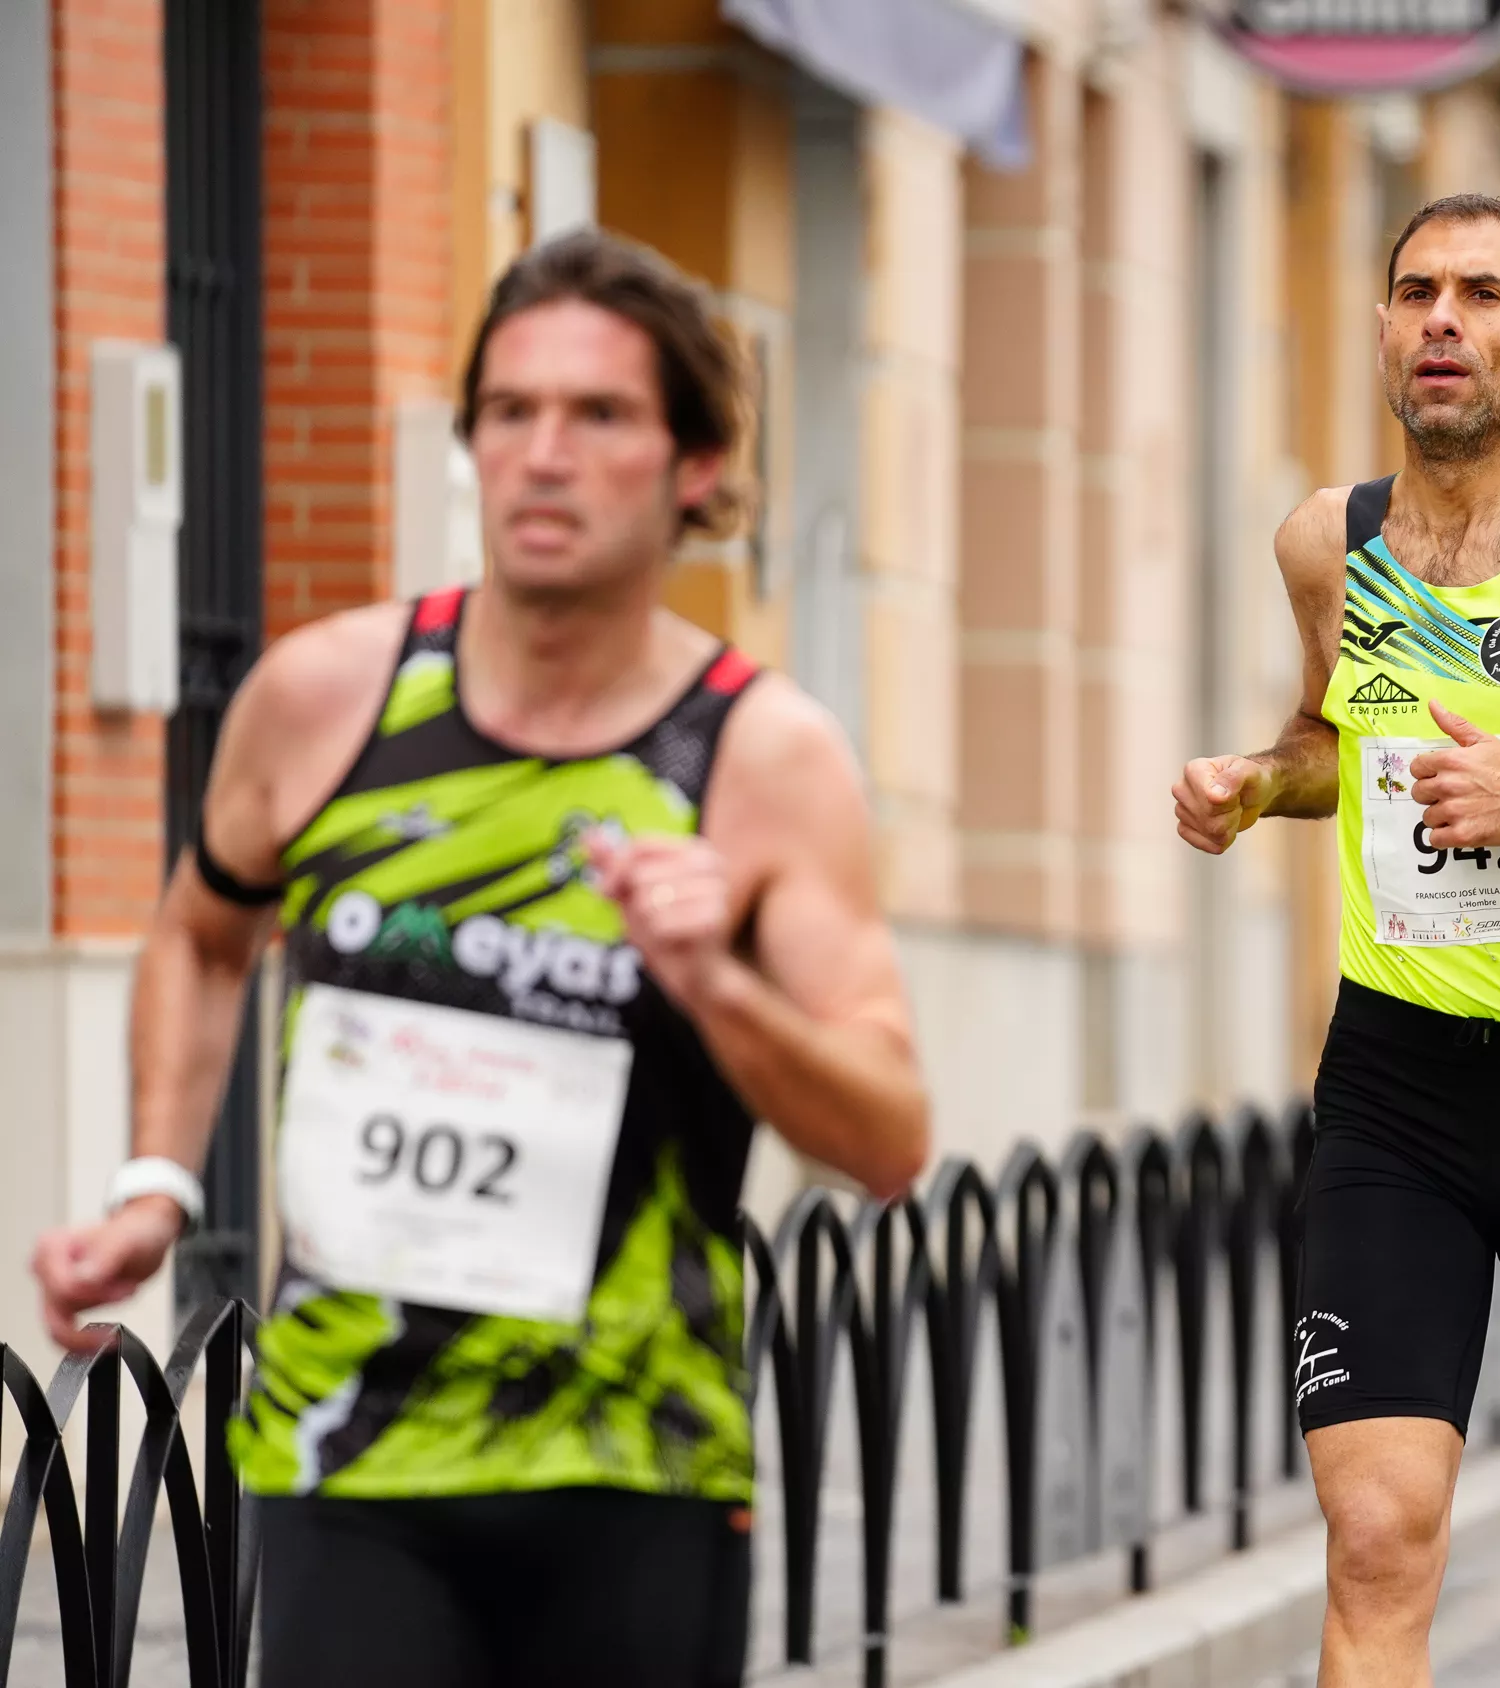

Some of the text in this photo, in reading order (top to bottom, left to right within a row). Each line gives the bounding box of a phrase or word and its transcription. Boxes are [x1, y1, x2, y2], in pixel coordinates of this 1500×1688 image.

[1488, 638, 1497, 649] Club
[1415, 890, 1457, 900] FRANCISCO
[1459, 887, 1477, 898] JOSÉ
[1459, 899, 1497, 909] L-Hombre
[356, 1111, 519, 1206] 902
[1311, 1310, 1350, 1331] Pontanés
[1307, 1370, 1350, 1395] del Canal
